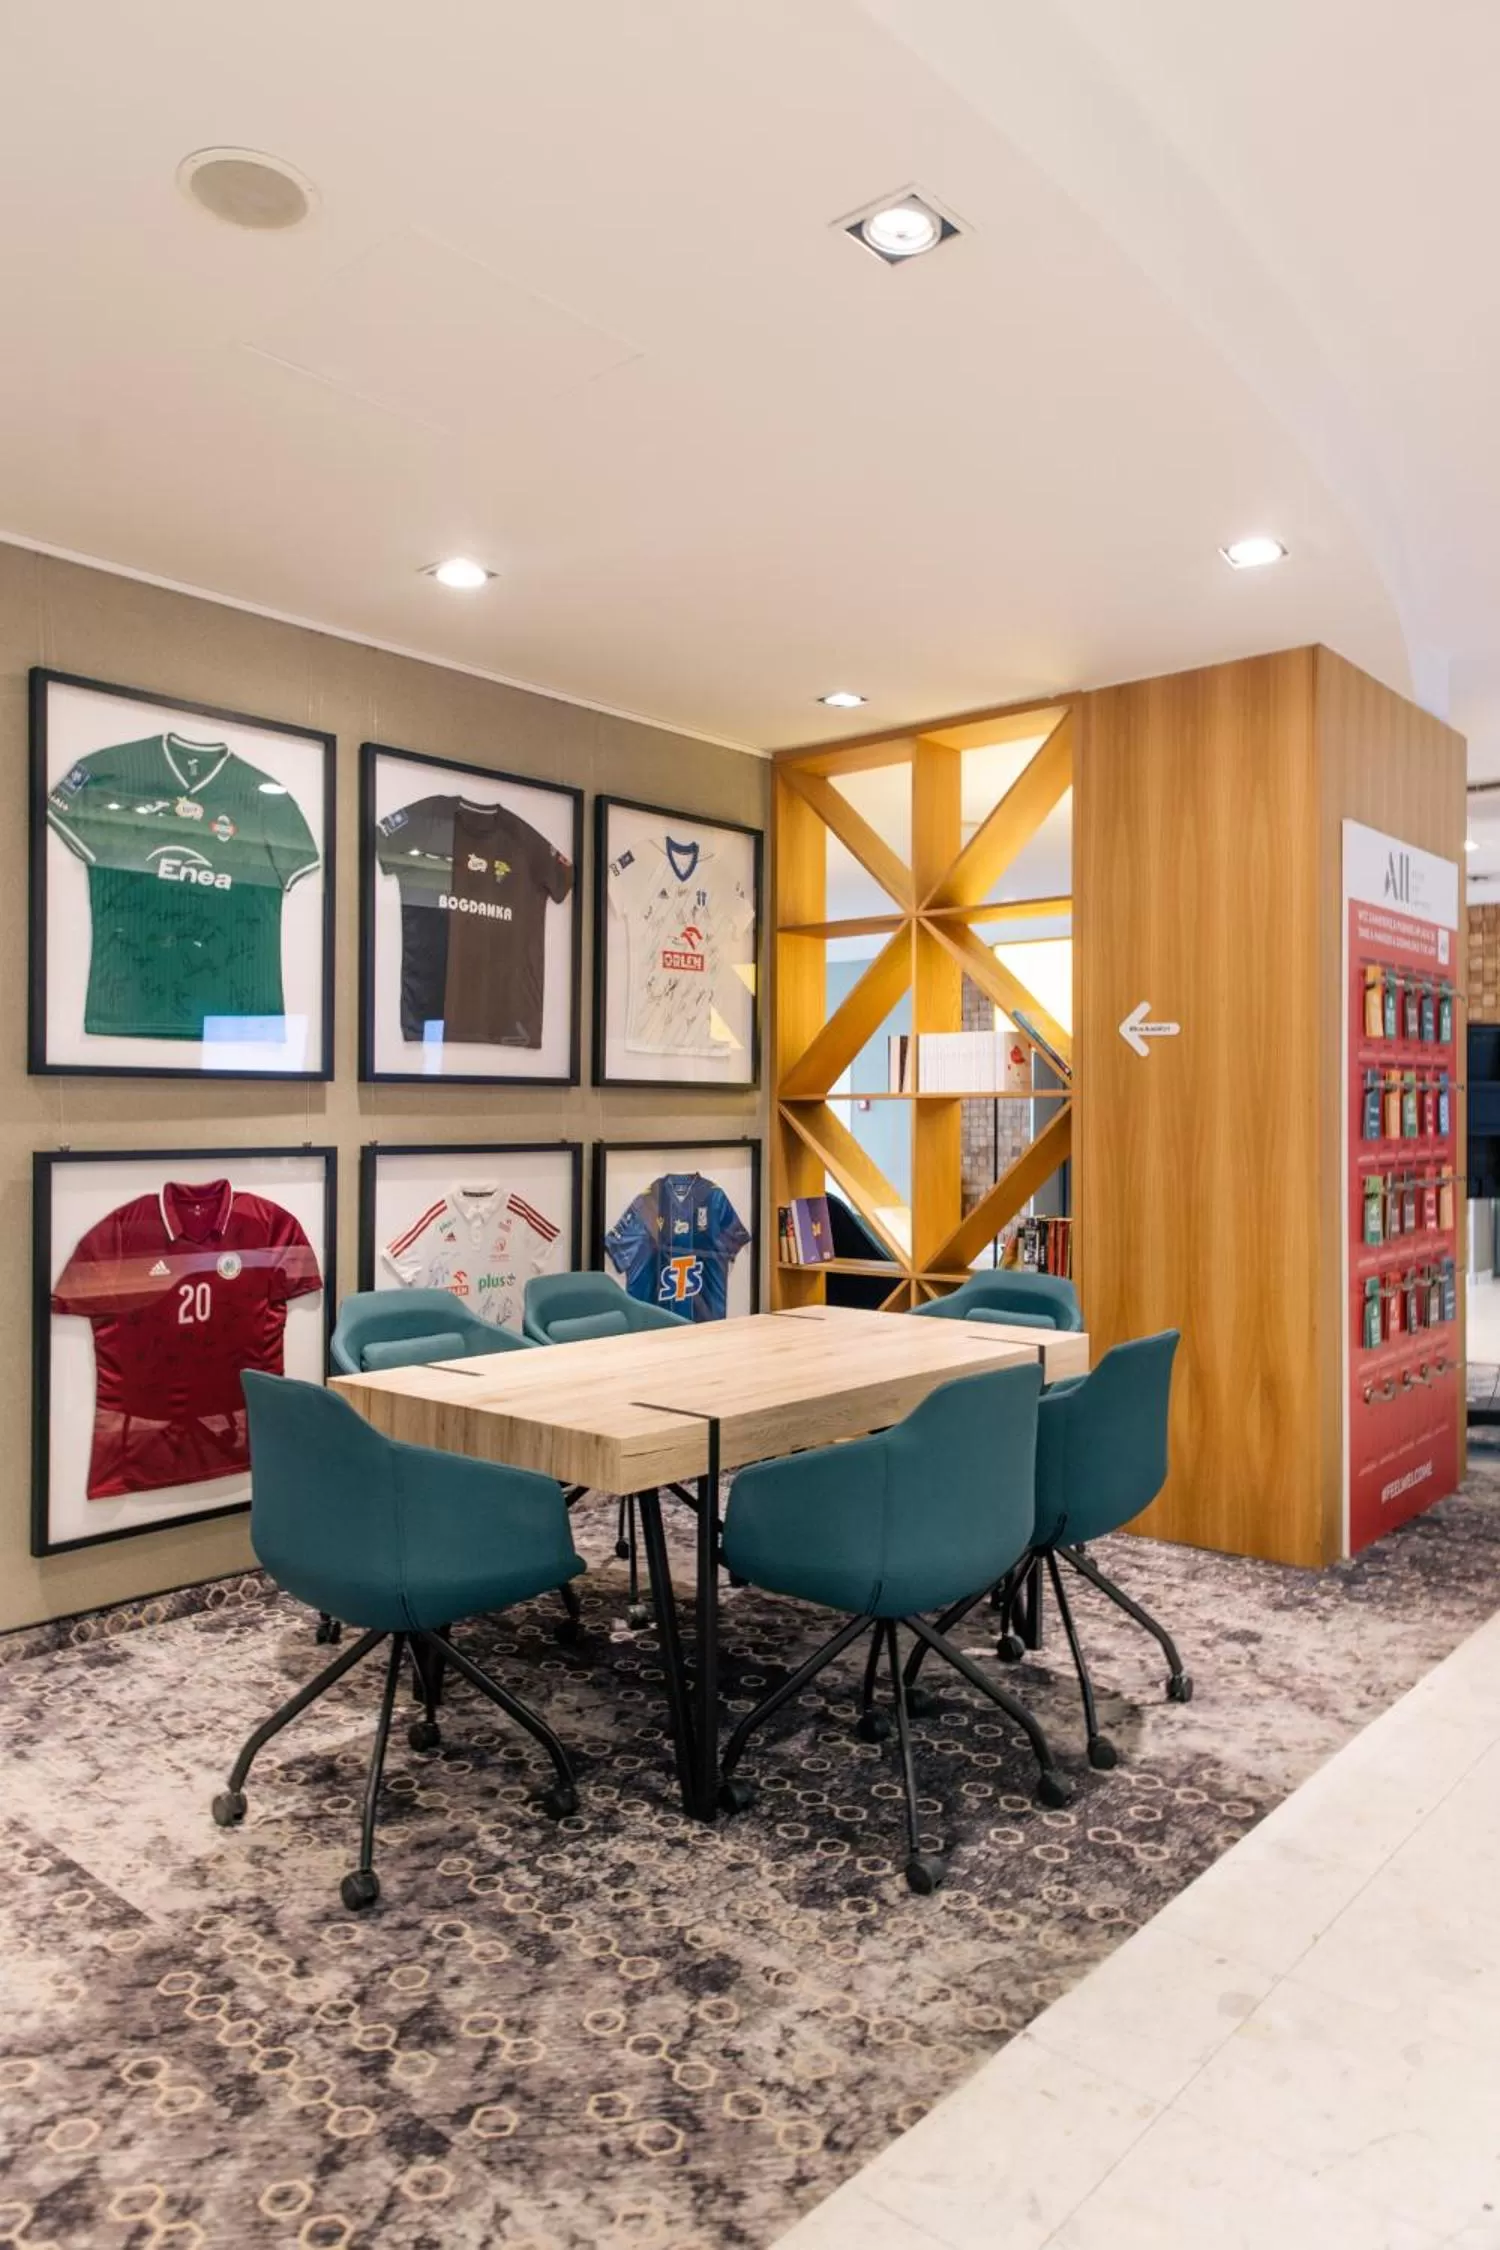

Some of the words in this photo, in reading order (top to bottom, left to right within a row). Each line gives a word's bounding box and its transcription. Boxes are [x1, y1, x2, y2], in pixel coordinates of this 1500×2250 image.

[158, 858, 231, 890] Enea
[439, 894, 512, 921] BOGDANKA
[664, 953, 702, 970] ORLEN
[659, 1255, 703, 1301] STS
[177, 1282, 211, 1324] 20
